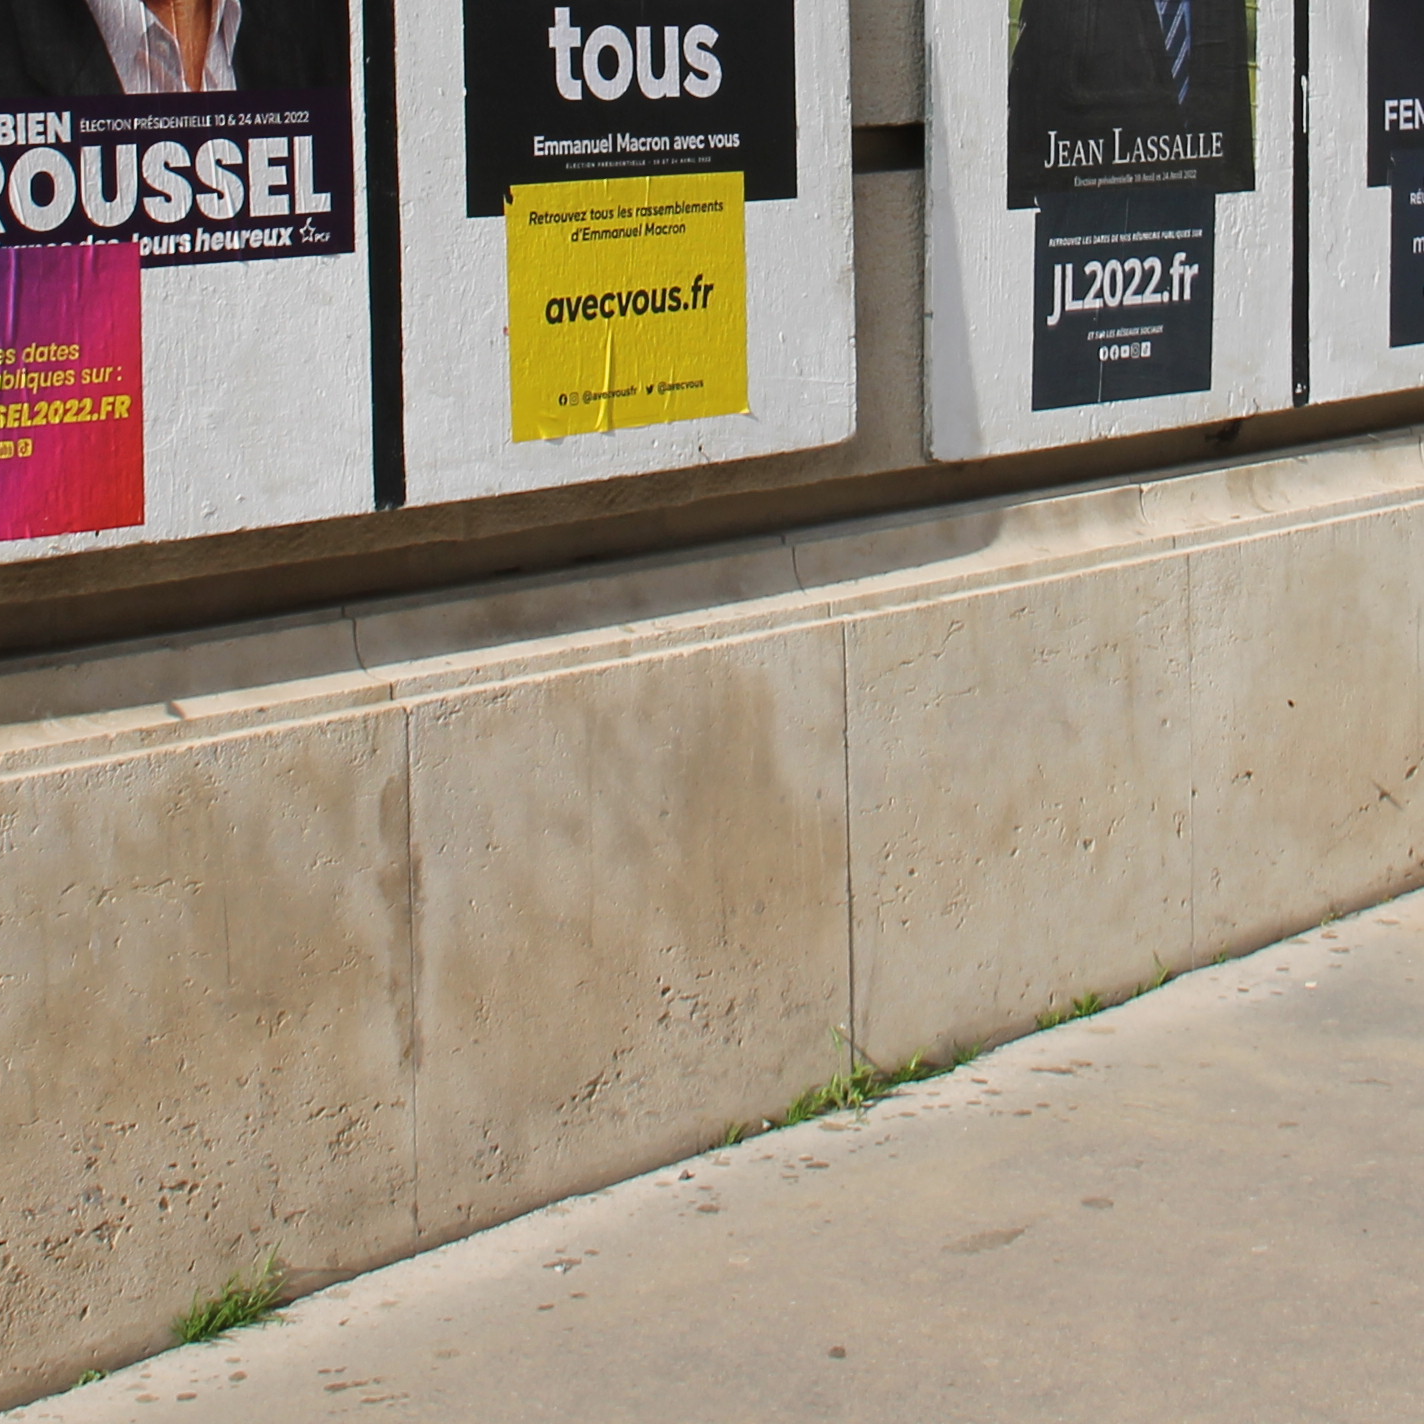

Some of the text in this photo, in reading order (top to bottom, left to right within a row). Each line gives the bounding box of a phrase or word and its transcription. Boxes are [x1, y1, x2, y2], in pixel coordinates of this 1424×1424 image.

[548, 7, 722, 101] tous
[80, 116, 133, 133] ÉLECTION
[133, 112, 212, 130] PRÉSIDENTIELLE
[214, 113, 226, 127] 10
[227, 113, 237, 127] &
[238, 112, 253, 126] 24
[254, 111, 281, 126] AVRIL
[283, 110, 310, 124] 2022
[533, 132, 740, 157] Emmanuel Macron avec vous
[1044, 127, 1224, 168] JEAN LASSALLE
[529, 200, 724, 226] Retrouvez tous les rassemblements
[195, 217, 293, 251] heureux
[571, 222, 686, 242] d'Emmanuel Macron
[545, 273, 715, 324] avecvous.fr
[1047, 252, 1199, 326] JL2022.fr
[22, 342, 80, 363] dates
[81, 366, 113, 384] sur
